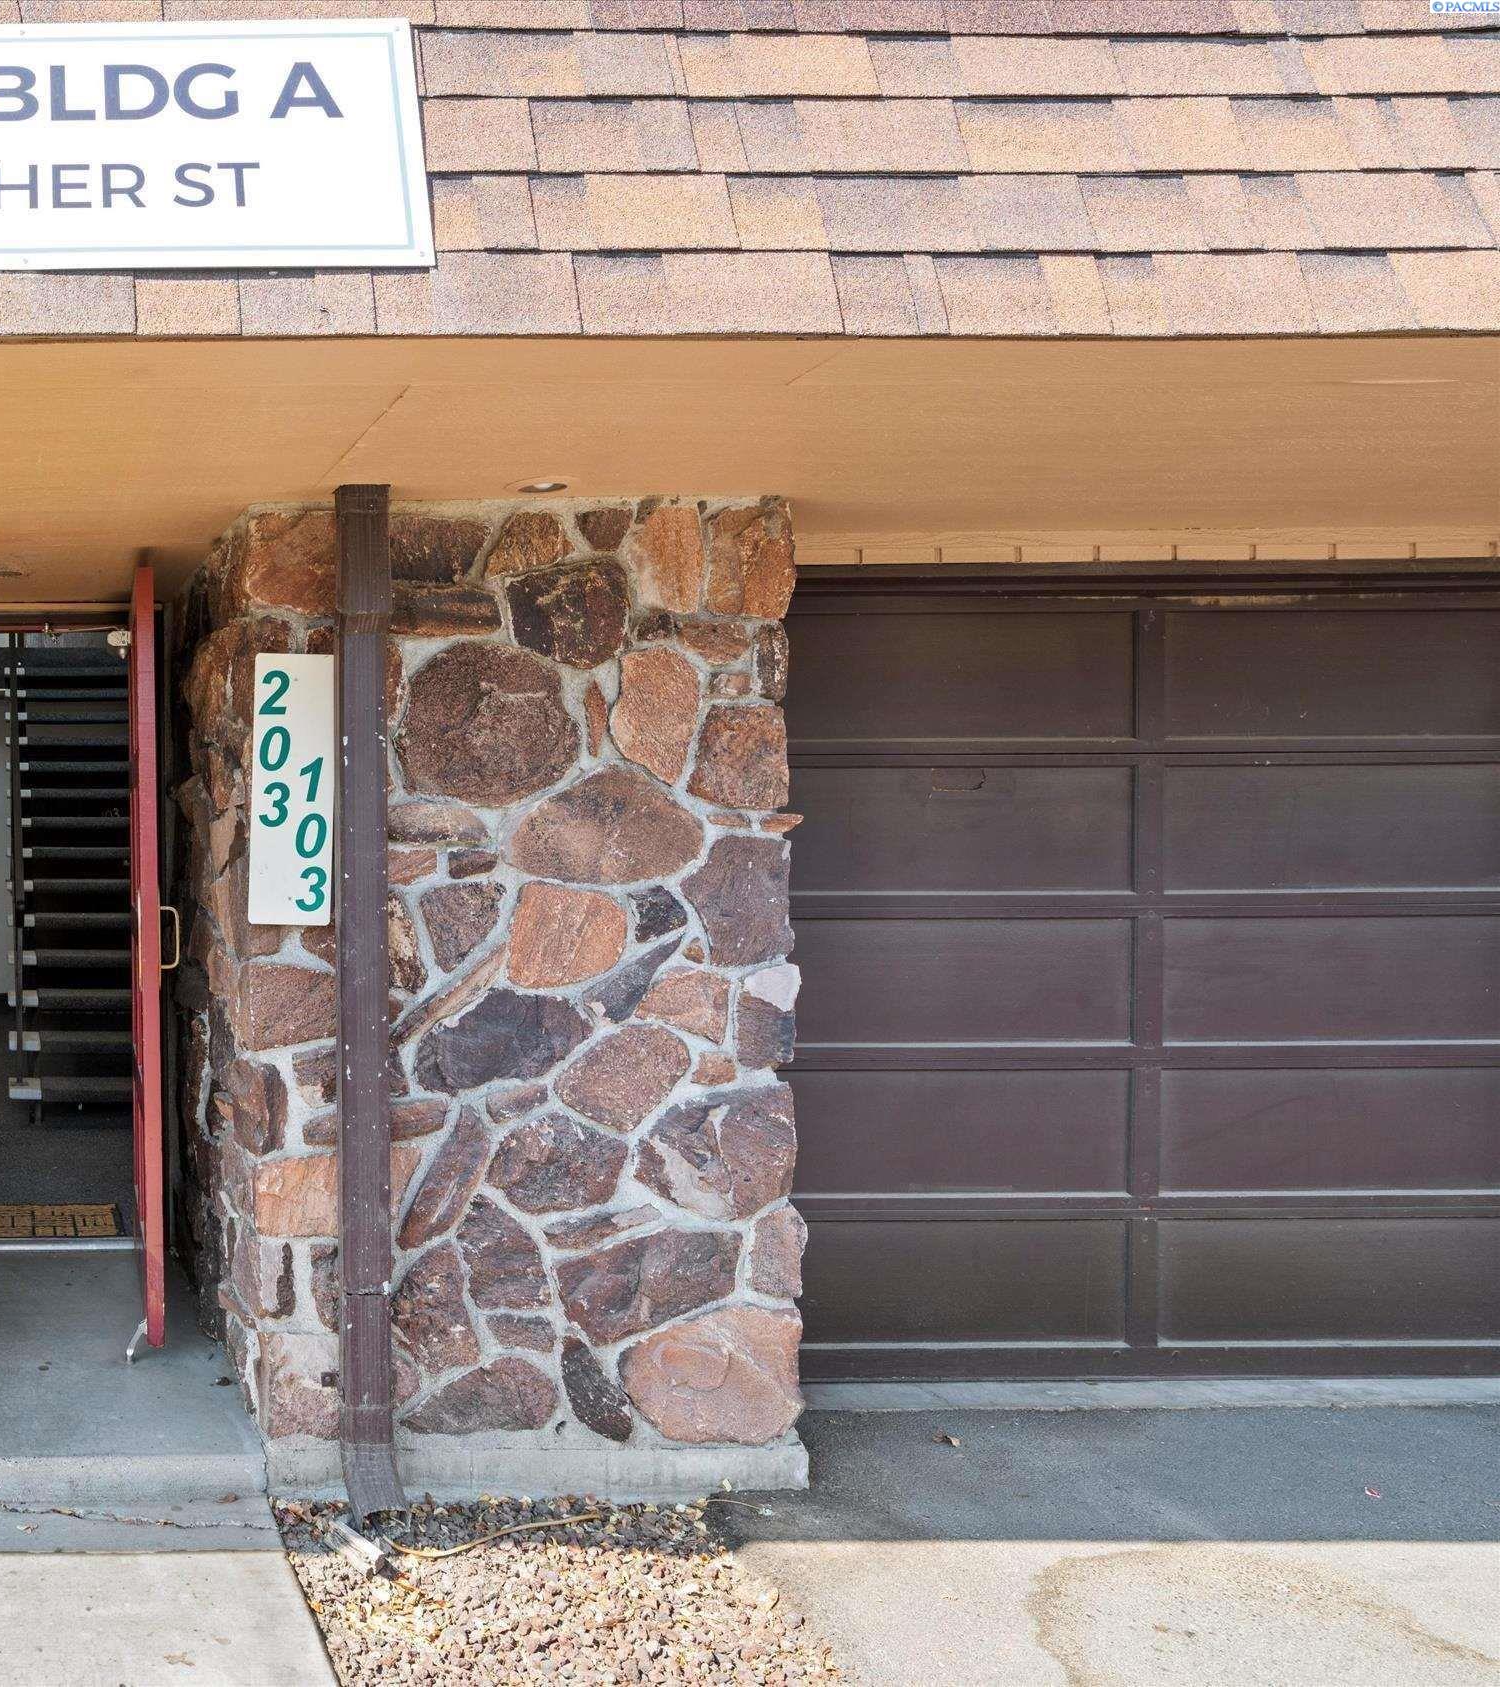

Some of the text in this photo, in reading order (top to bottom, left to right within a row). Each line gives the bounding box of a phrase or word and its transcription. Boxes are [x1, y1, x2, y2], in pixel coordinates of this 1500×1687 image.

[270, 61, 344, 119] A
[172, 161, 260, 208] ST
[258, 670, 291, 828] 203
[295, 756, 327, 912] 103
